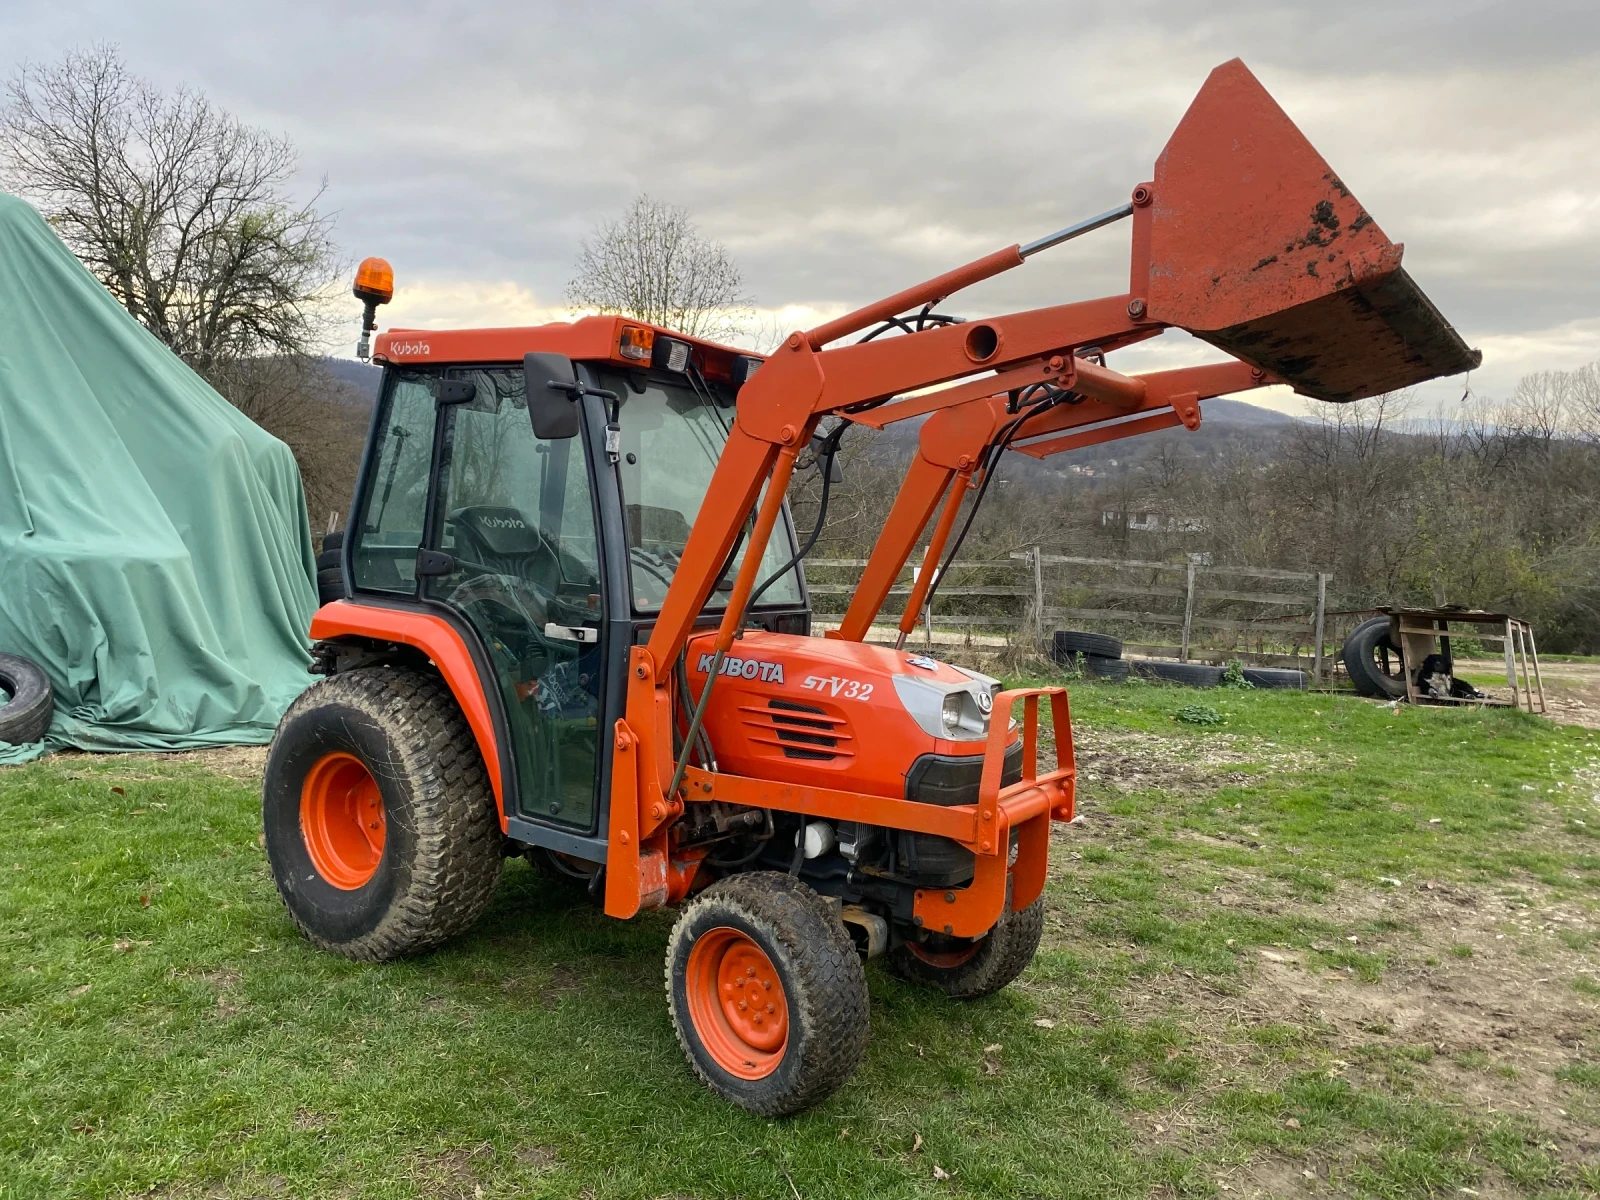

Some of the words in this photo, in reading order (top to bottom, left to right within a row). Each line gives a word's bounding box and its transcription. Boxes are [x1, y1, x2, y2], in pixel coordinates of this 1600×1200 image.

[390, 341, 430, 355] Kubota
[479, 516, 526, 529] Kubota
[697, 653, 784, 684] KUBOTA
